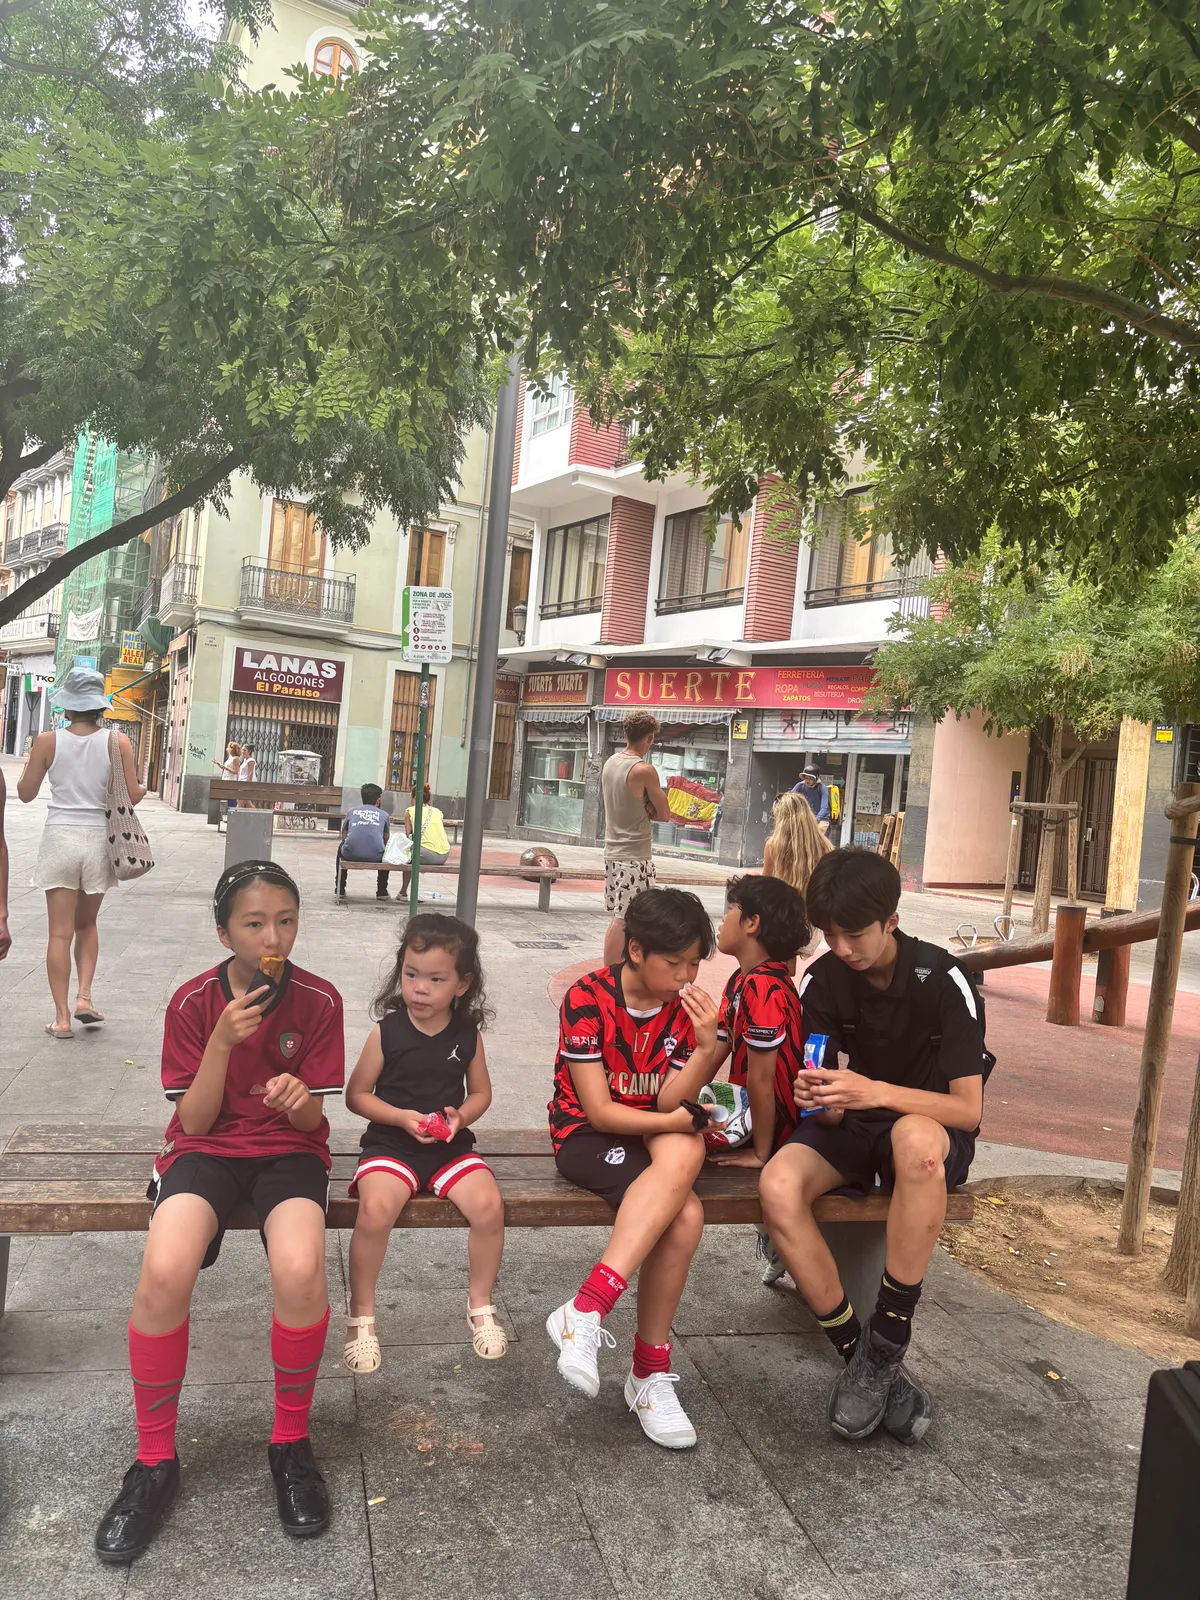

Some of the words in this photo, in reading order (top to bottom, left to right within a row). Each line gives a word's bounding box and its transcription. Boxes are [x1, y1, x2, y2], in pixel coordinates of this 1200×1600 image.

[123, 649, 144, 658] JALEA
[124, 642, 145, 650] POLEN
[123, 656, 143, 664] REAL
[242, 651, 337, 679] LANAS
[253, 671, 325, 688] ALGODONES
[528, 675, 553, 692] SUERTE
[557, 673, 583, 692] SUERTE
[777, 670, 825, 679] FERRETERIA
[256, 681, 269, 692] El
[273, 684, 320, 698] Paraiso
[614, 671, 756, 703] SUERTE
[775, 684, 798, 694] ROPA
[633, 1032, 650, 1053] 17
